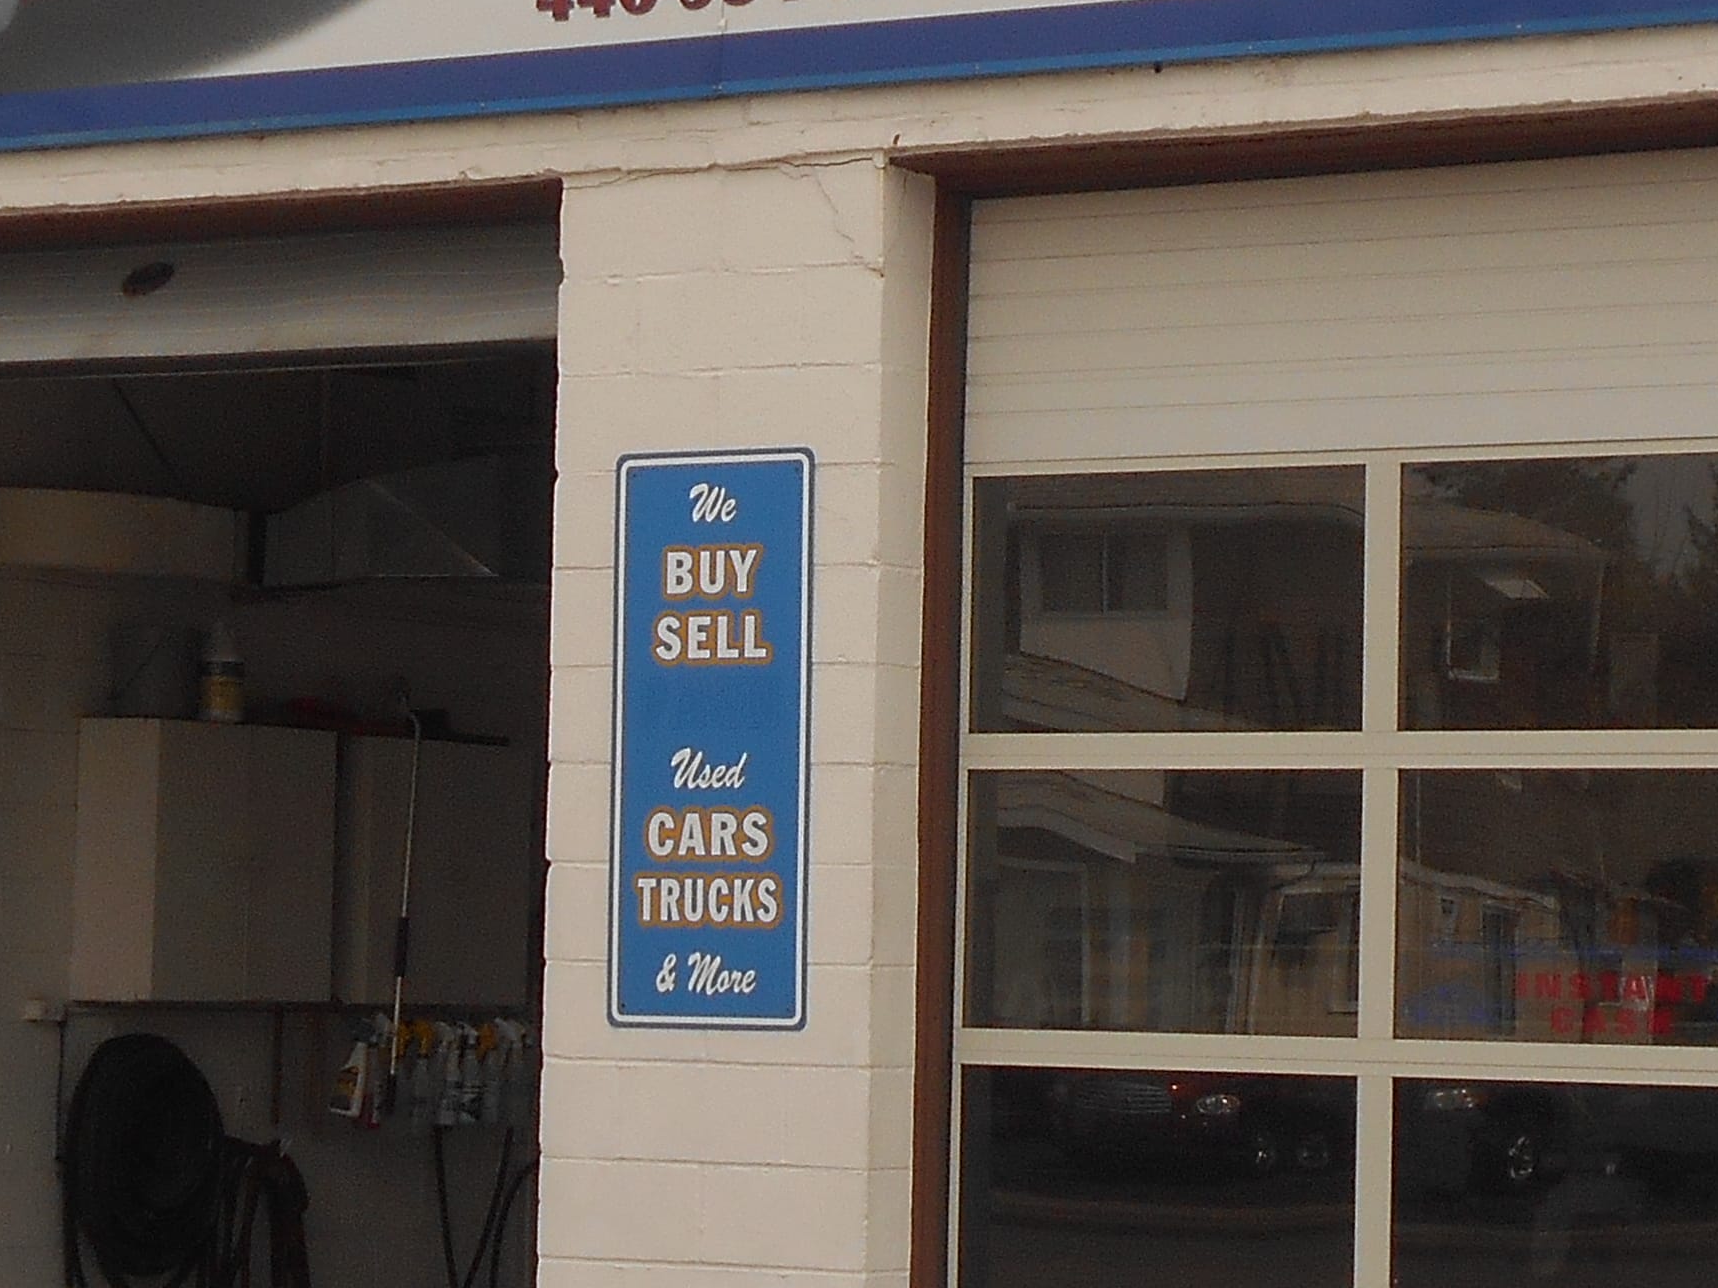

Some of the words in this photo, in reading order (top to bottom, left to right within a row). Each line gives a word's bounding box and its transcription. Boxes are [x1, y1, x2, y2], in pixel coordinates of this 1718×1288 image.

[688, 482, 737, 523] We
[665, 548, 758, 596] BUY
[655, 614, 768, 661] SELL
[670, 747, 748, 790] Used
[647, 811, 769, 856] CARS
[637, 877, 779, 923] TRUCKS
[655, 952, 676, 993] &
[687, 950, 756, 996] More
[1516, 970, 1712, 1004] INSTANT
